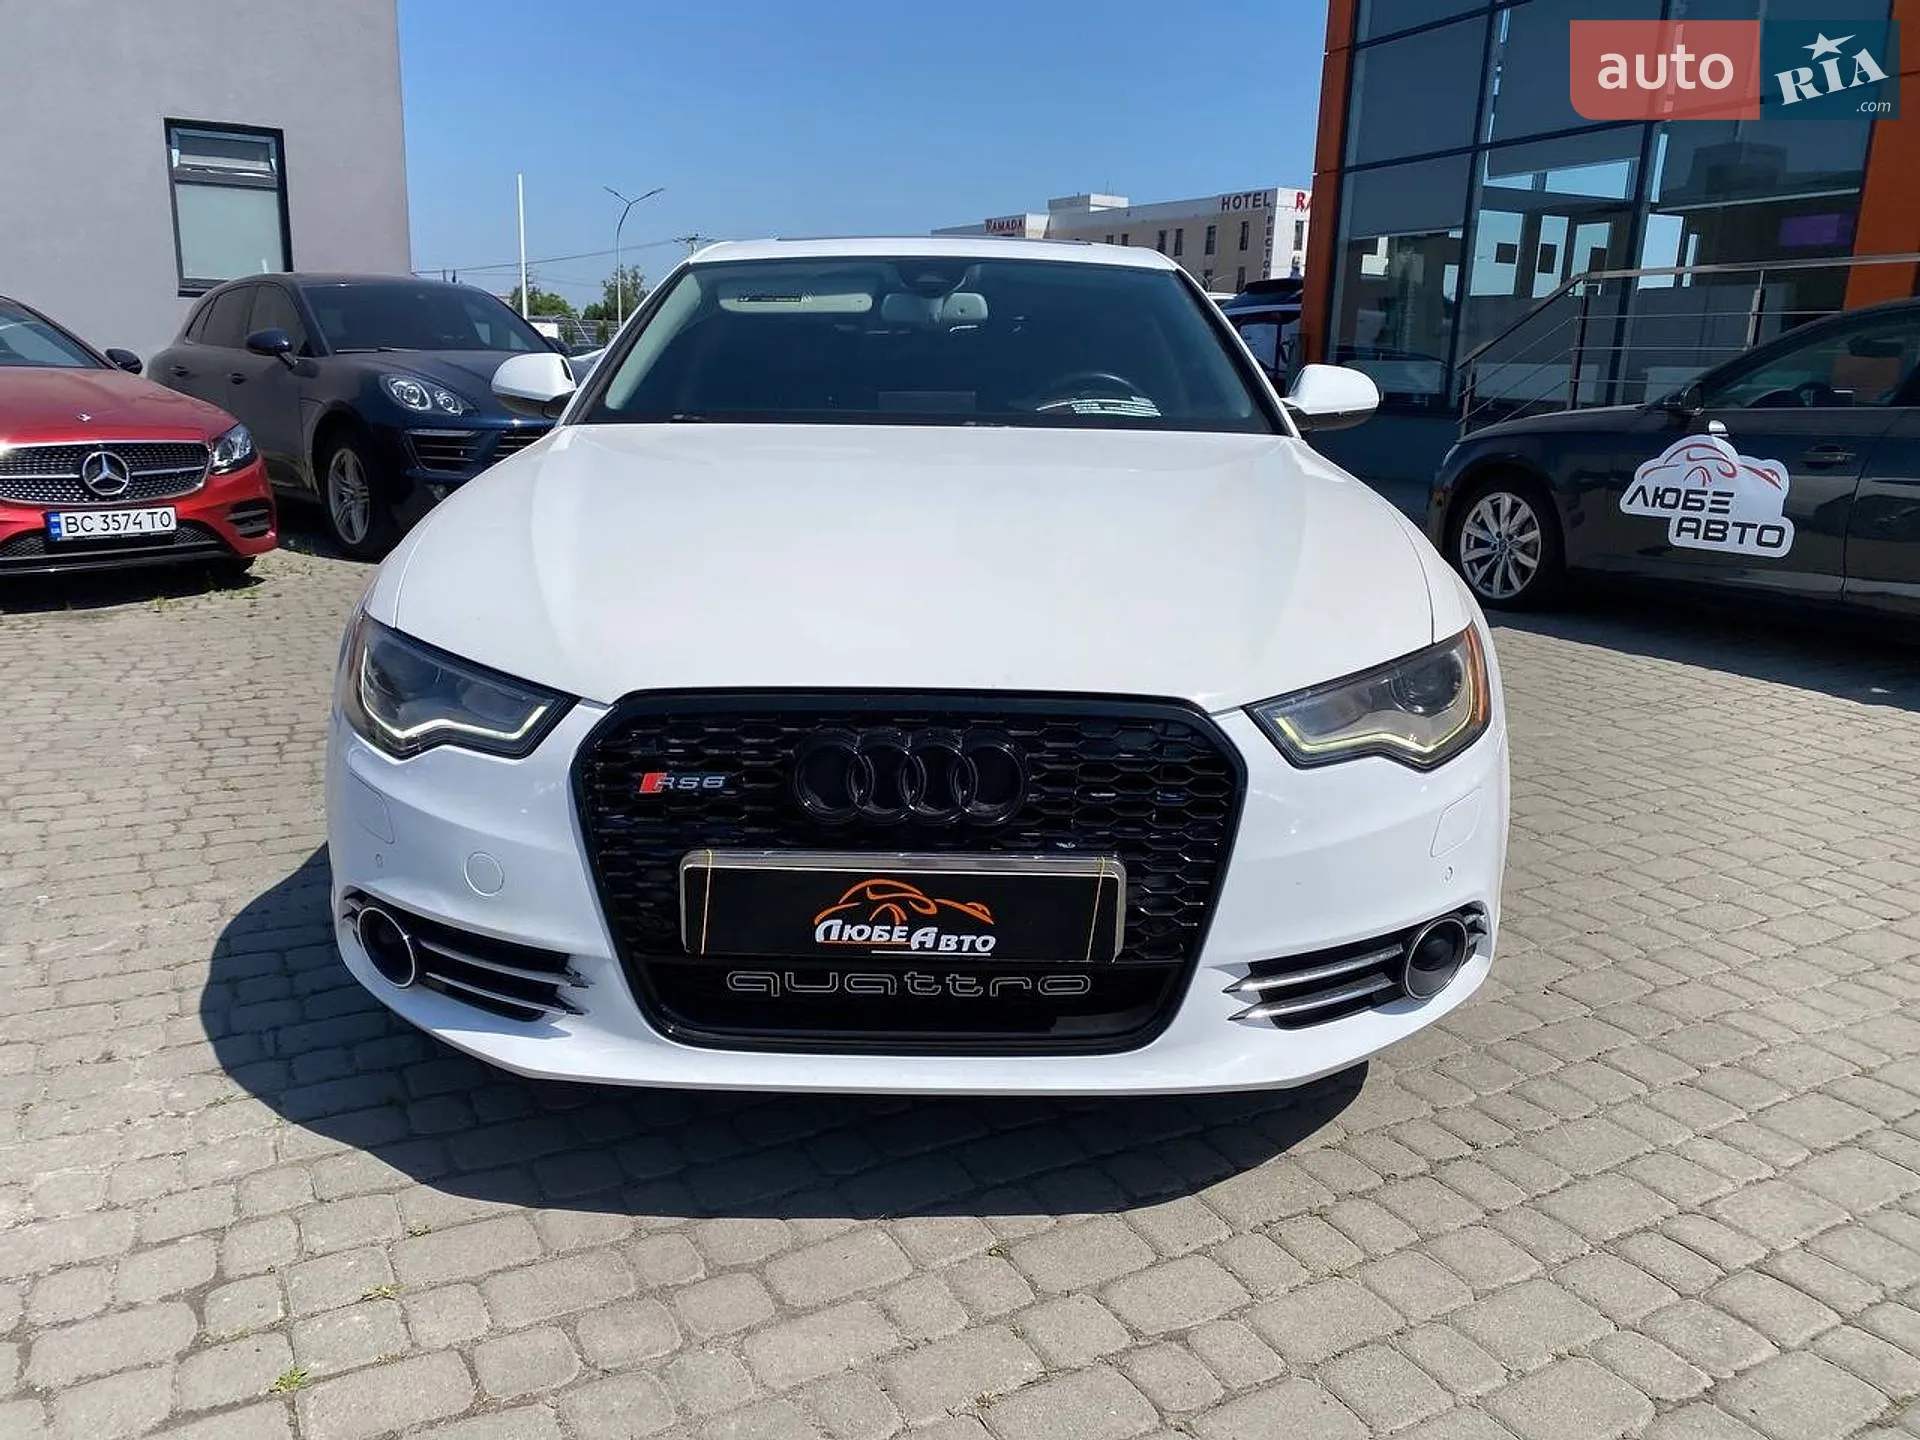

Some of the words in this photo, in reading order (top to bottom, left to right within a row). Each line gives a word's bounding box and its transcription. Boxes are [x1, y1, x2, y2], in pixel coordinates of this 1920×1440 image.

[1221, 192, 1271, 211] HOTEL
[1627, 485, 1735, 515] ЛЮБЕ
[65, 514, 94, 533] BC
[99, 512, 143, 532] 3574
[145, 511, 172, 530] TO
[1675, 516, 1786, 549] АВТО
[726, 970, 1091, 998] quattro
